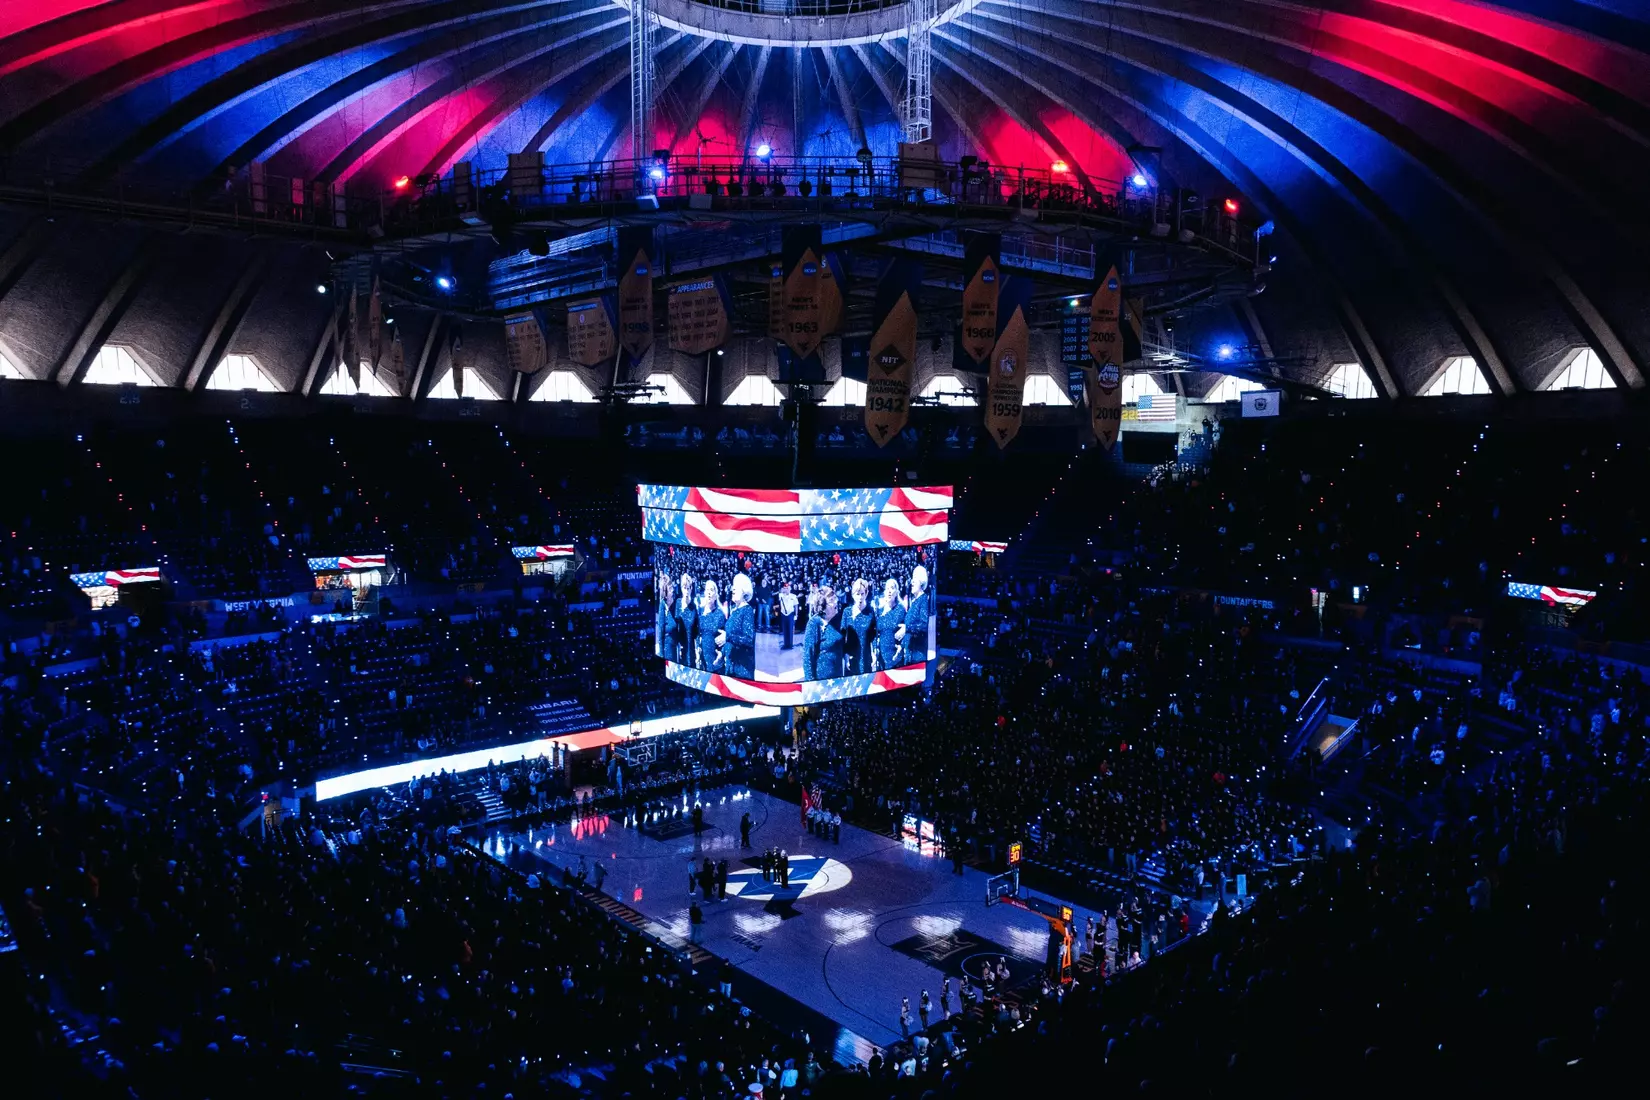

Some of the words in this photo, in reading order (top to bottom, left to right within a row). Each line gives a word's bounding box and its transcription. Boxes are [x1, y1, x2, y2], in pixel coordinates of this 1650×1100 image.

[676, 280, 715, 293] APPEARANCES
[788, 322, 818, 333] 1963
[1092, 332, 1116, 342] 2005
[881, 356, 899, 364] NIT
[869, 397, 904, 413] 1942
[993, 402, 1021, 417] 1959
[1095, 407, 1120, 420] 2010
[225, 602, 250, 612] WEST
[1010, 850, 1020, 863] 30
